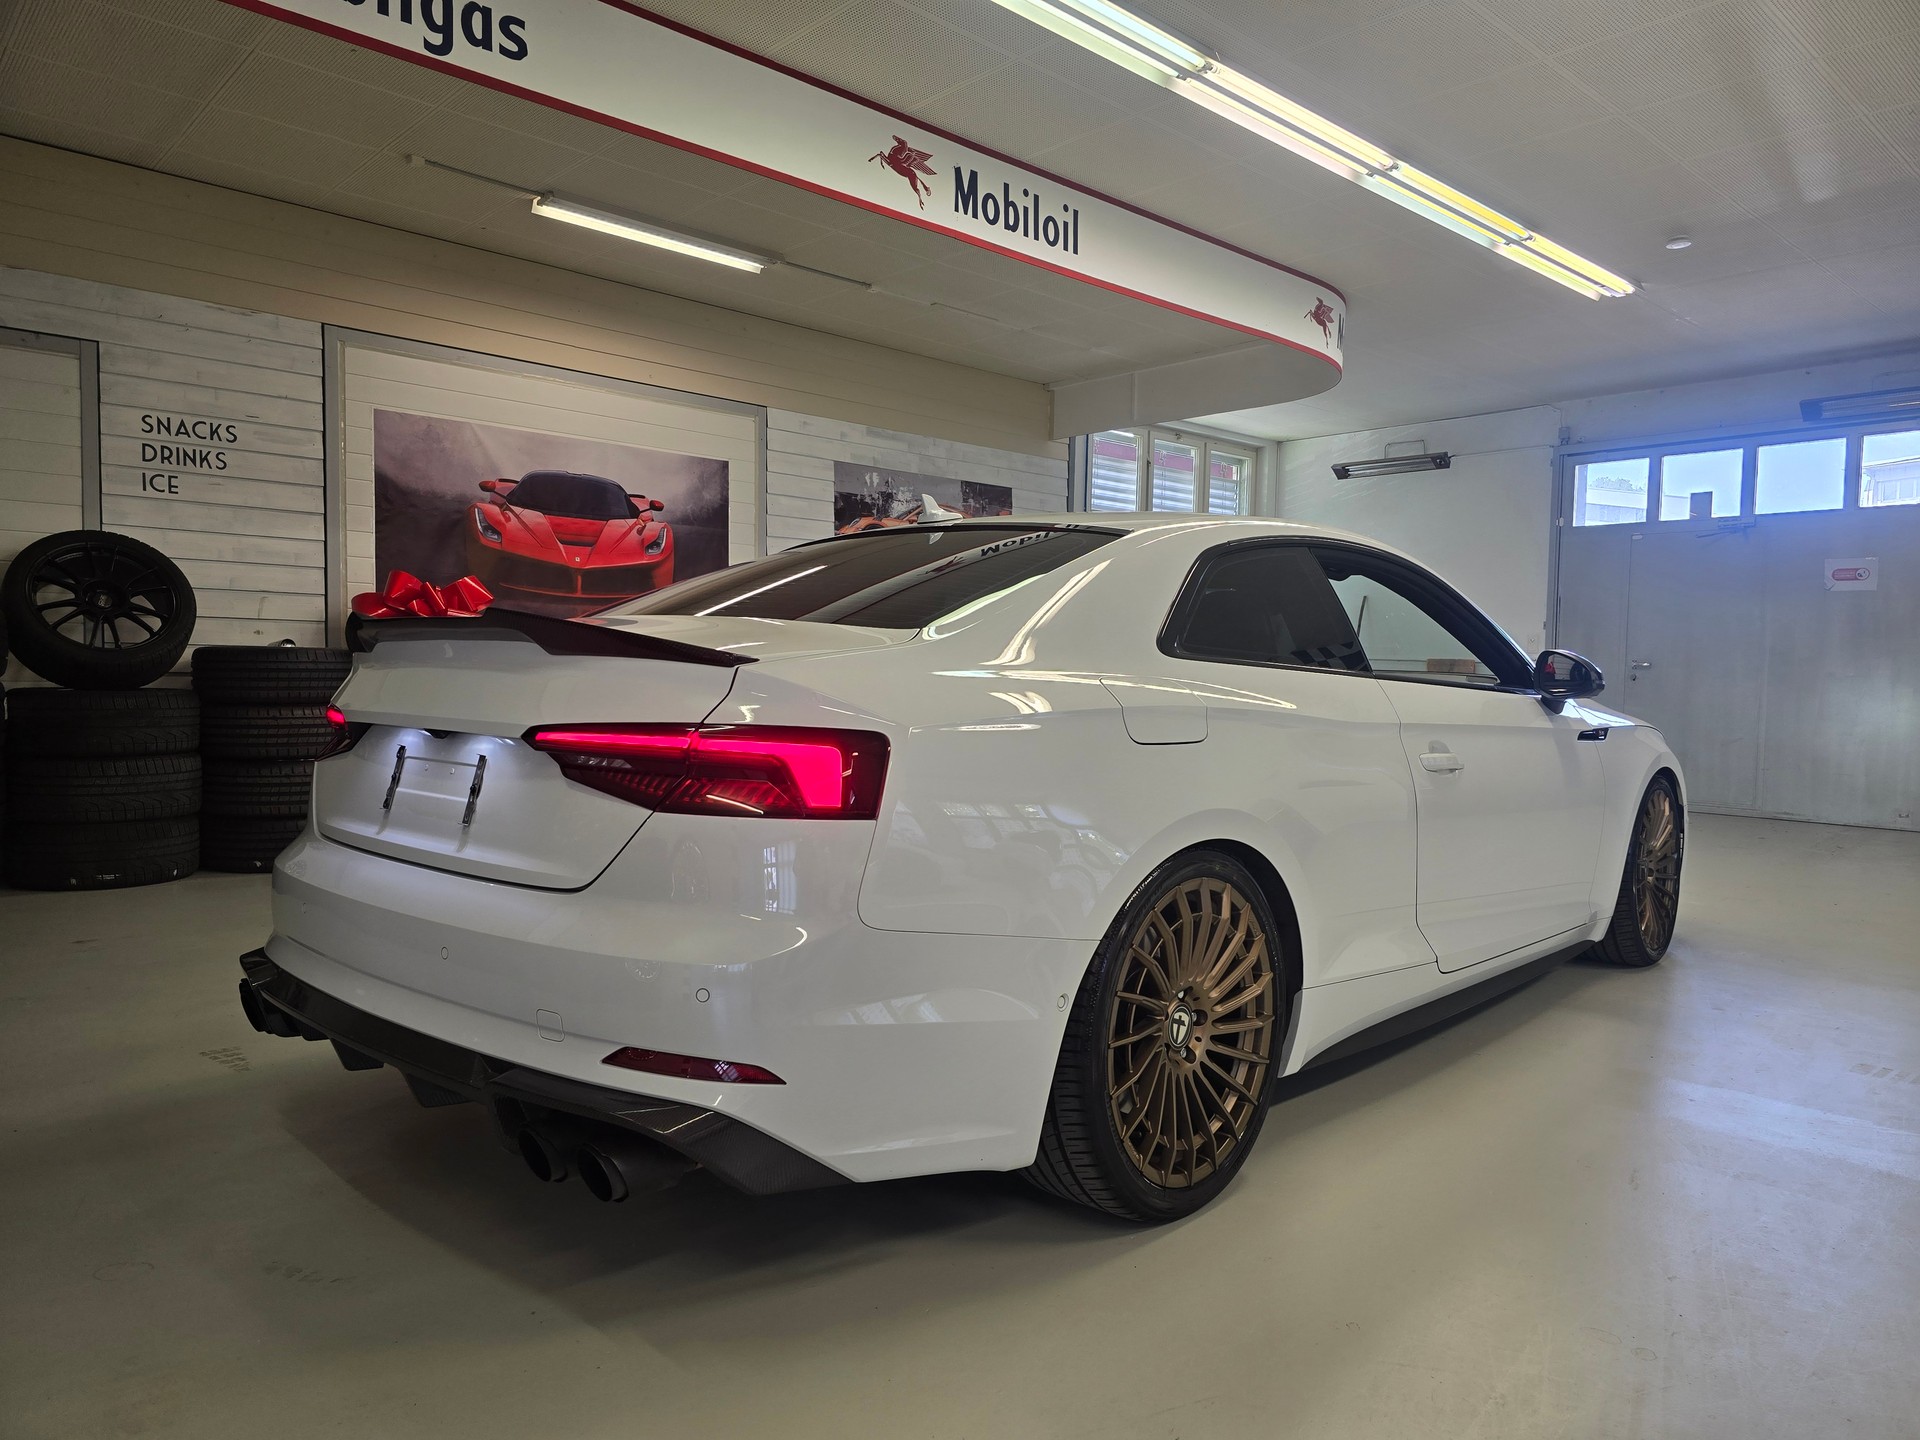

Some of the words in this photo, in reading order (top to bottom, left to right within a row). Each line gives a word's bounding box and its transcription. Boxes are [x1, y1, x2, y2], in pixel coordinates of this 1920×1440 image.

[953, 165, 1079, 256] Mobiloil
[141, 414, 238, 443] SNACKS
[141, 442, 228, 470] DRINKS
[141, 472, 179, 495] ICE
